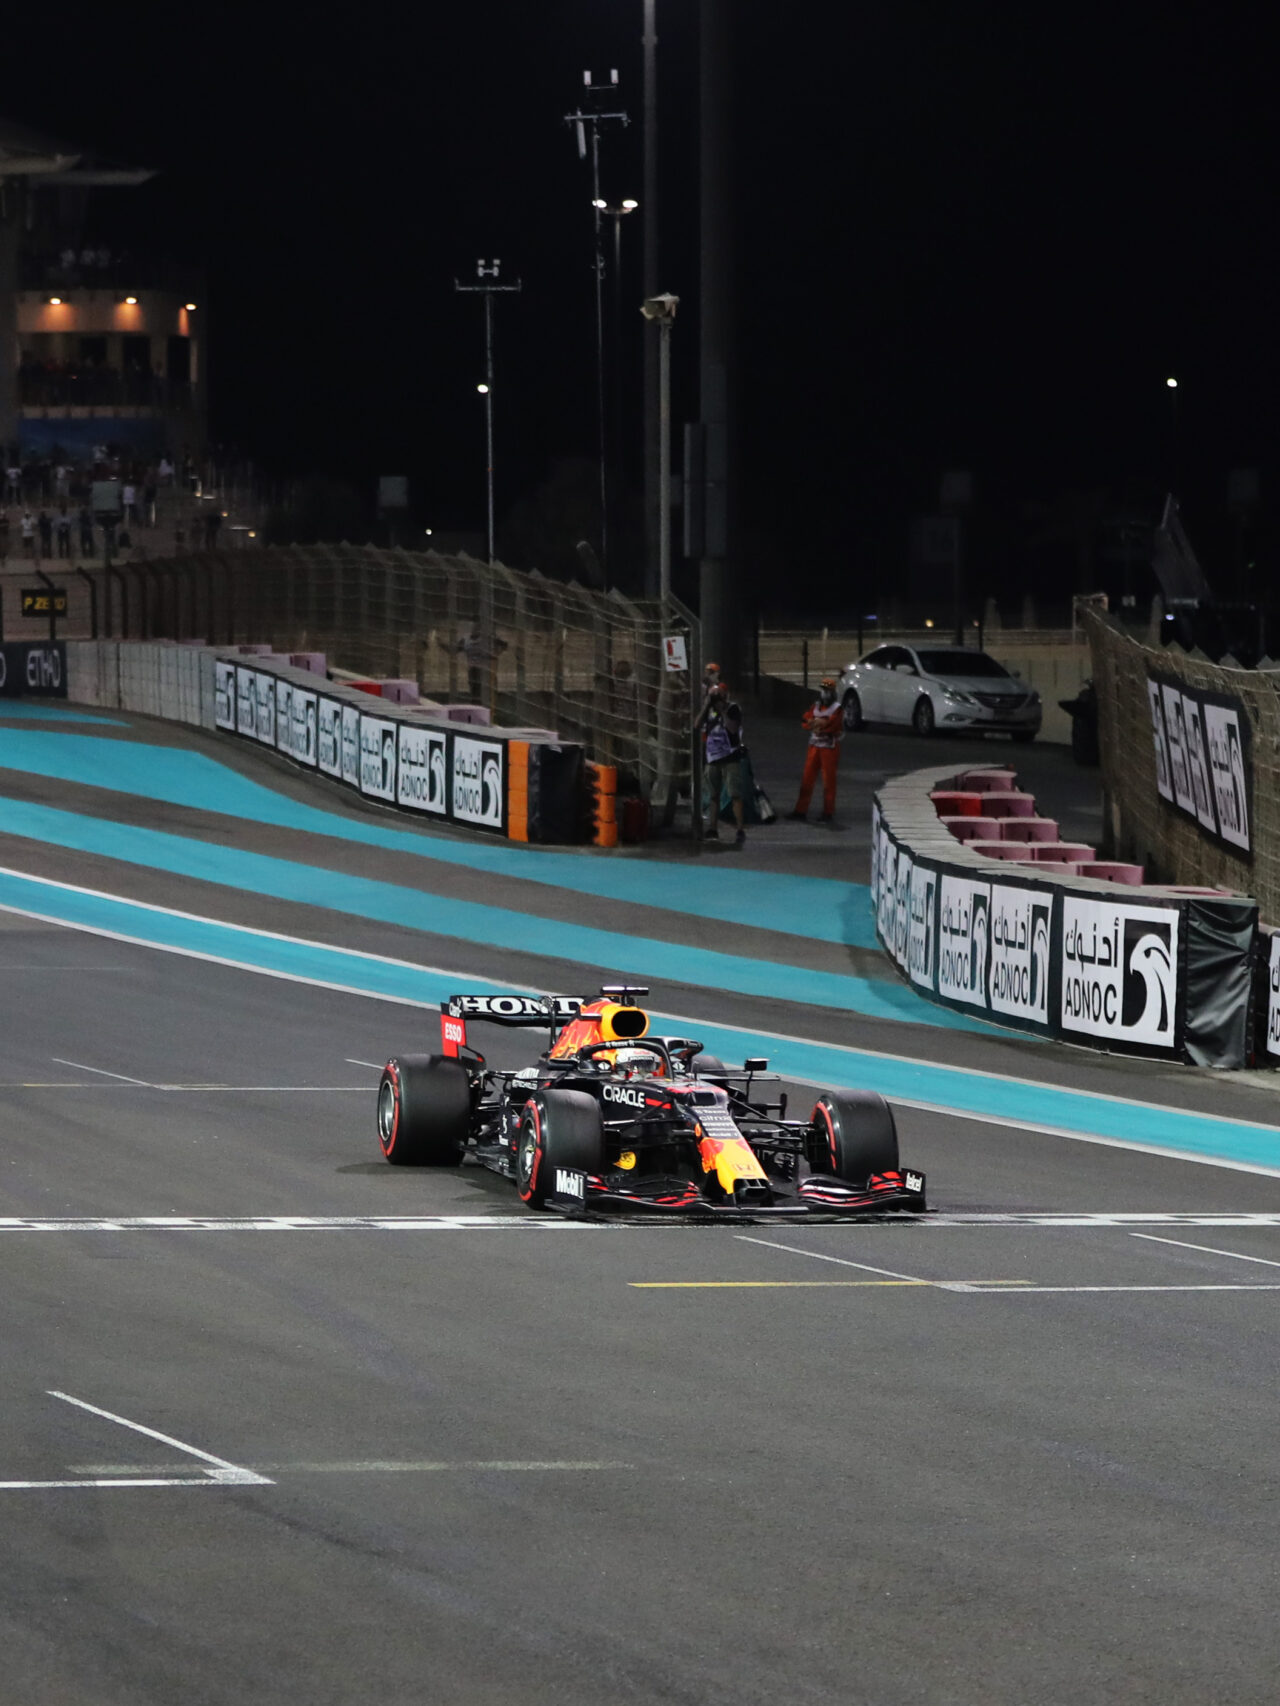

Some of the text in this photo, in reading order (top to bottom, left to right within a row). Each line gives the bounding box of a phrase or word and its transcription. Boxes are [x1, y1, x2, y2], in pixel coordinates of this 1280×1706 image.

[401, 772, 428, 801] ADNOC
[455, 786, 480, 815] ADNOC
[994, 904, 1030, 957] أدنوك
[1065, 916, 1119, 973] أدنوك
[941, 949, 969, 990] ADNOC
[993, 961, 1029, 1005] ADNOC
[461, 996, 584, 1015] HOND
[1065, 977, 1117, 1025] ADNOC
[445, 1022, 462, 1043] ESSO
[603, 1086, 645, 1108] ORACLE
[556, 1169, 579, 1196] Mobil
